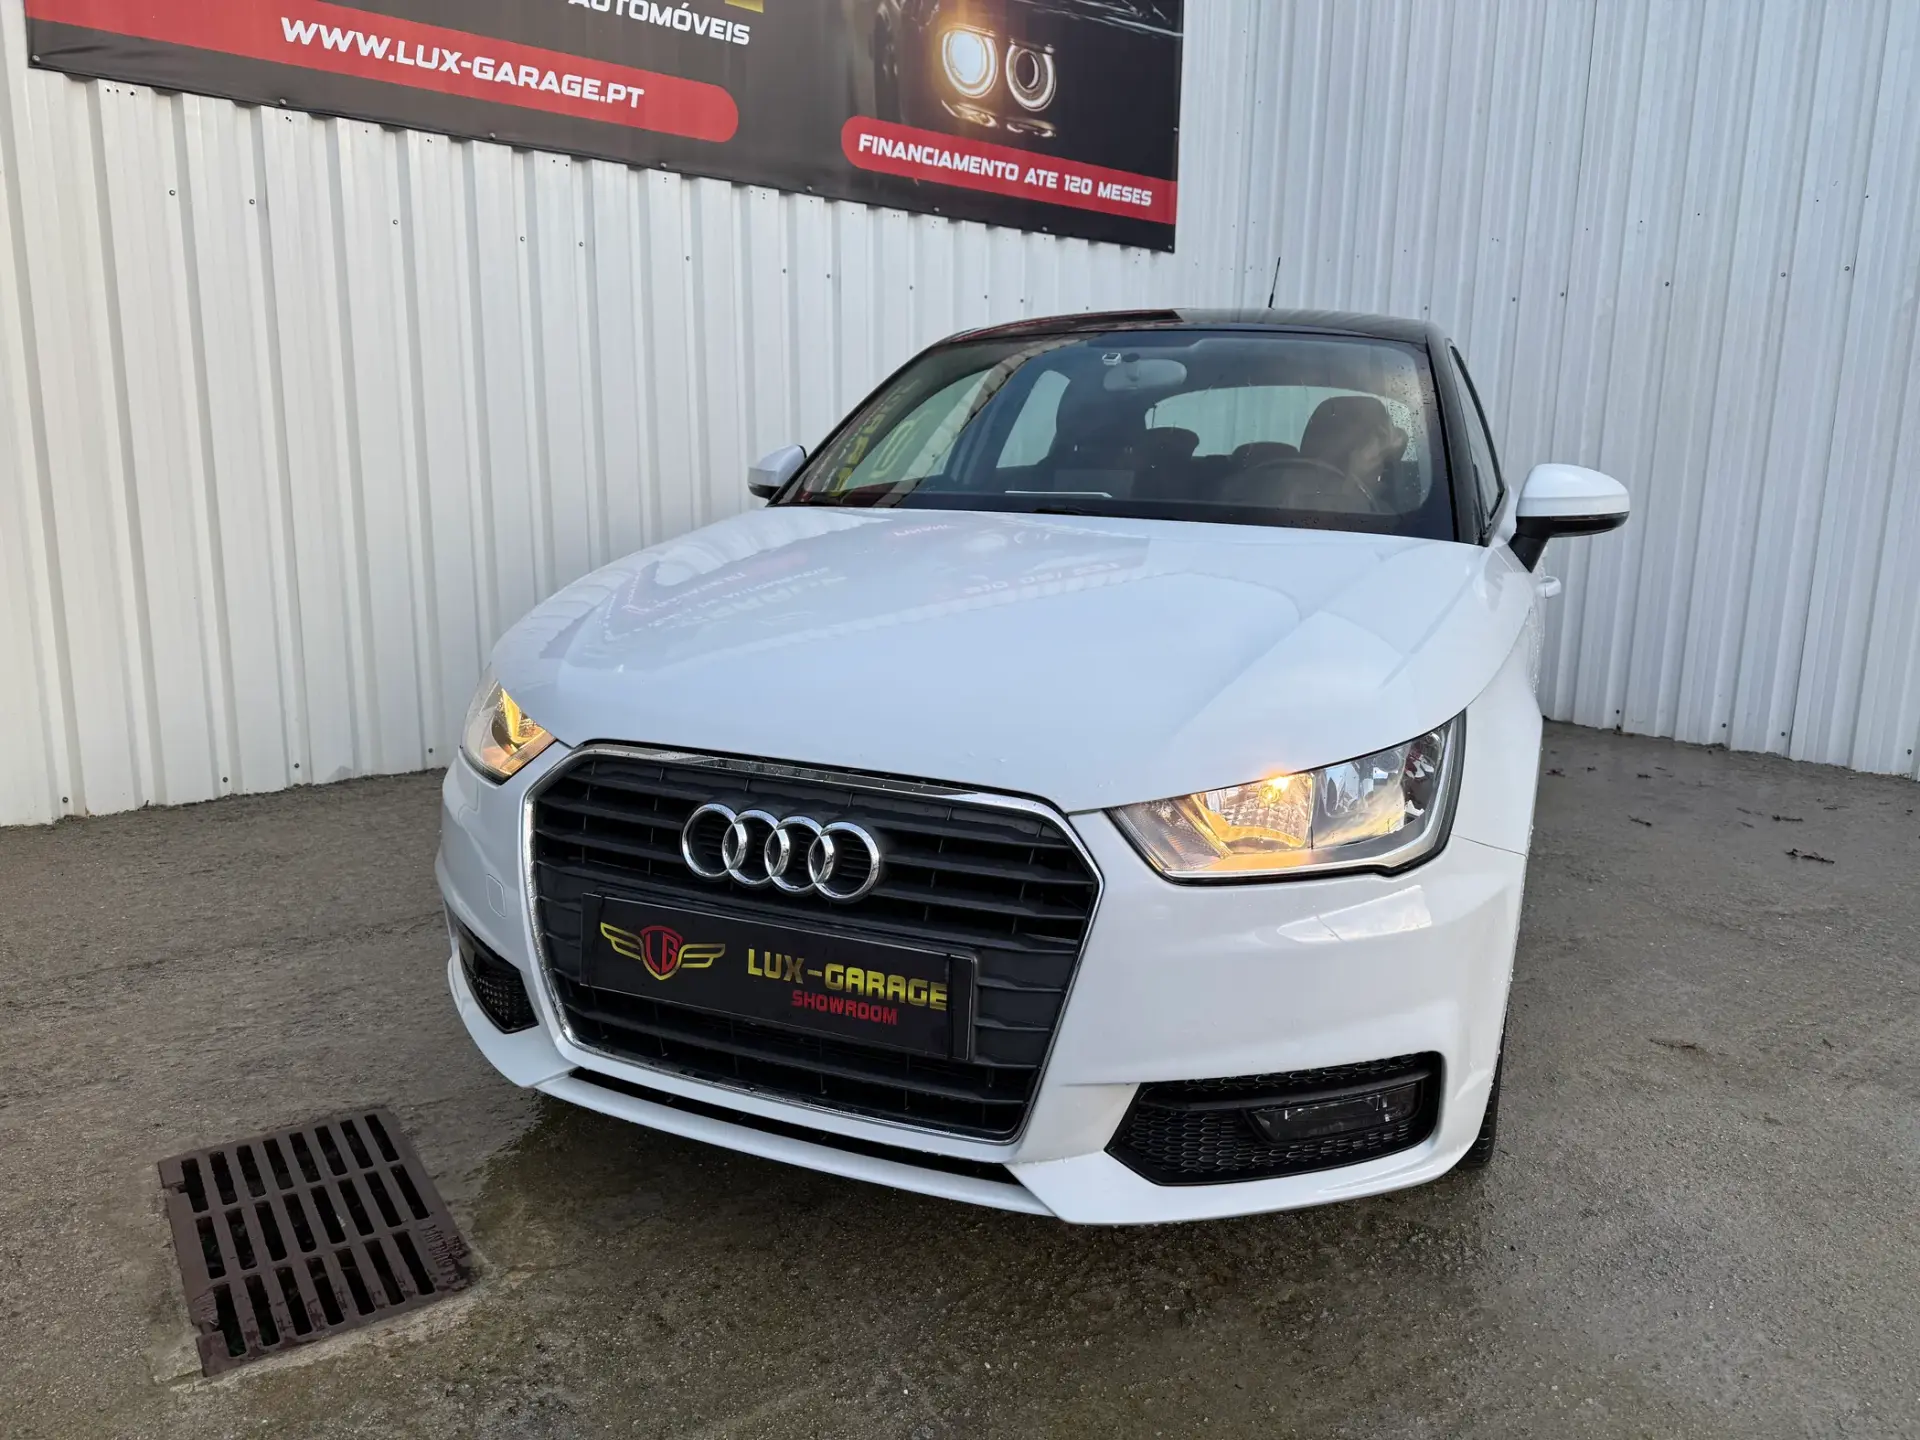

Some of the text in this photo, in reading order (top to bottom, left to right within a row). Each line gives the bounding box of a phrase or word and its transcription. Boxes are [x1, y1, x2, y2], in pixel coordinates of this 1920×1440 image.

[280, 16, 645, 108] WWW.LUX-GARAGE.PT
[858, 133, 1153, 207] FINANCIAMENTO ATE 120 MESES
[747, 948, 948, 1012] LUX-GARAGE
[791, 989, 898, 1025] SHOWROOM
